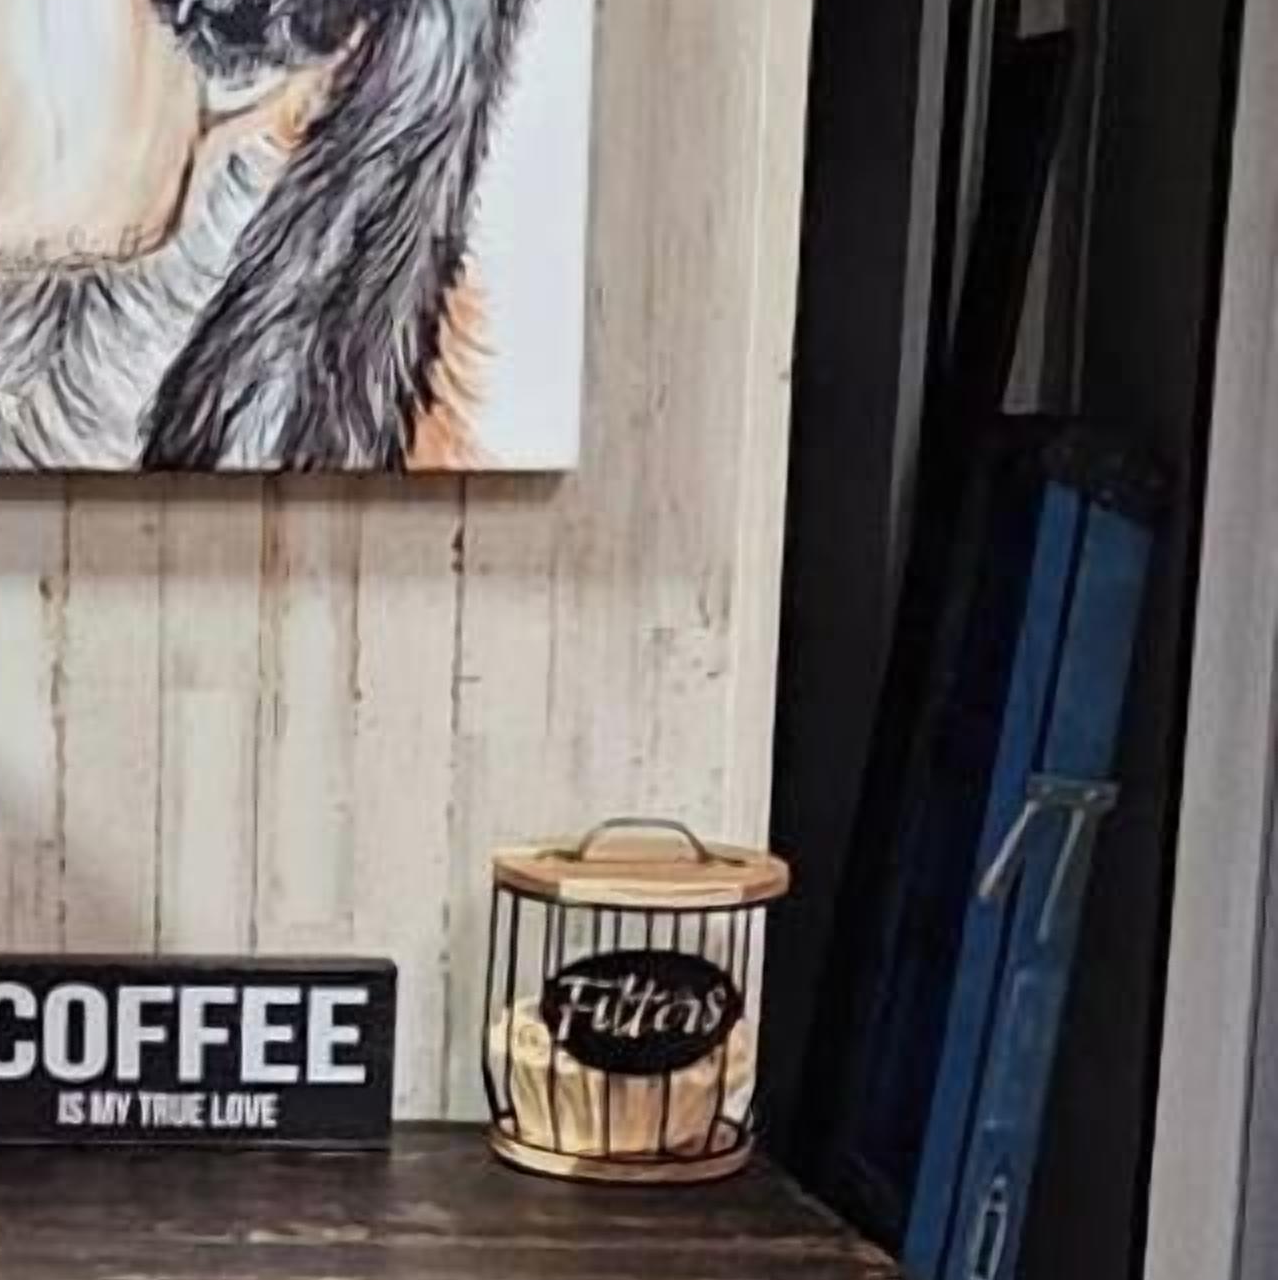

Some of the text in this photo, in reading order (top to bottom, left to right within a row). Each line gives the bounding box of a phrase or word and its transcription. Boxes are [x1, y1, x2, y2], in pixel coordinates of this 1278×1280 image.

[57, 1091, 279, 1129] IS MY TRUE LOVE
